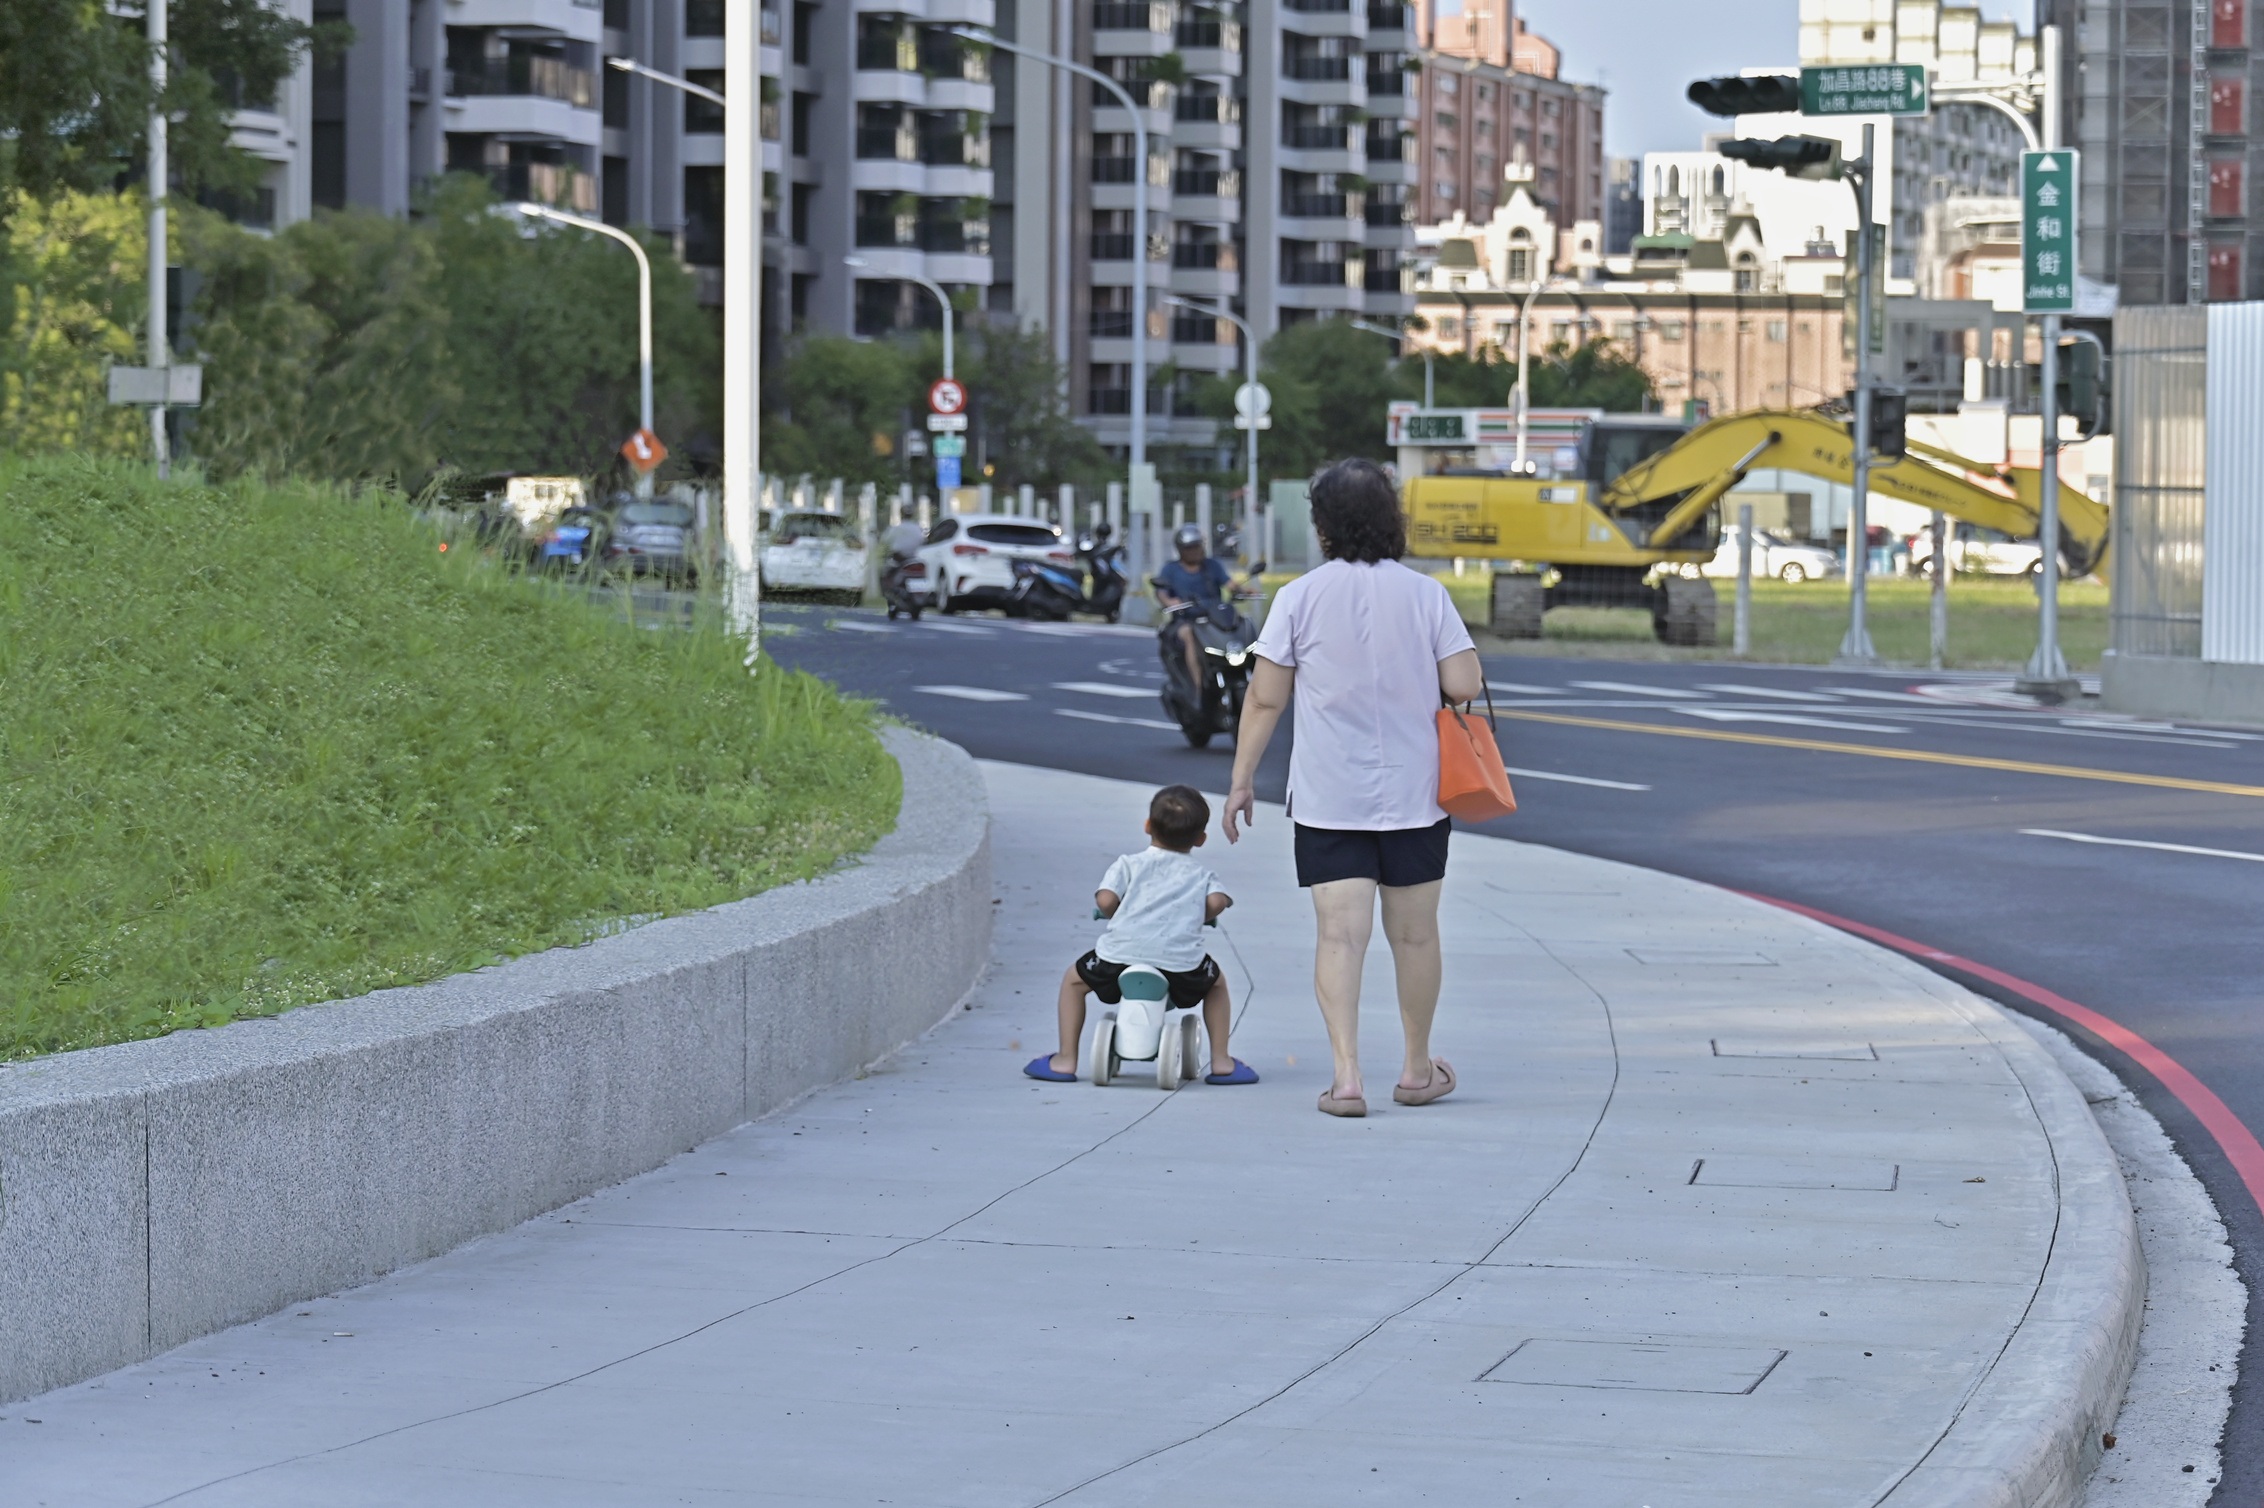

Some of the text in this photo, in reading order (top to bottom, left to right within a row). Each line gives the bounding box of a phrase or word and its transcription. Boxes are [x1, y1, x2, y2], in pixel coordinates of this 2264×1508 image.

[1818, 67, 1906, 93] 加昌路88巷
[2036, 180, 2062, 277] 金和街
[2026, 284, 2055, 299] Jinhe
